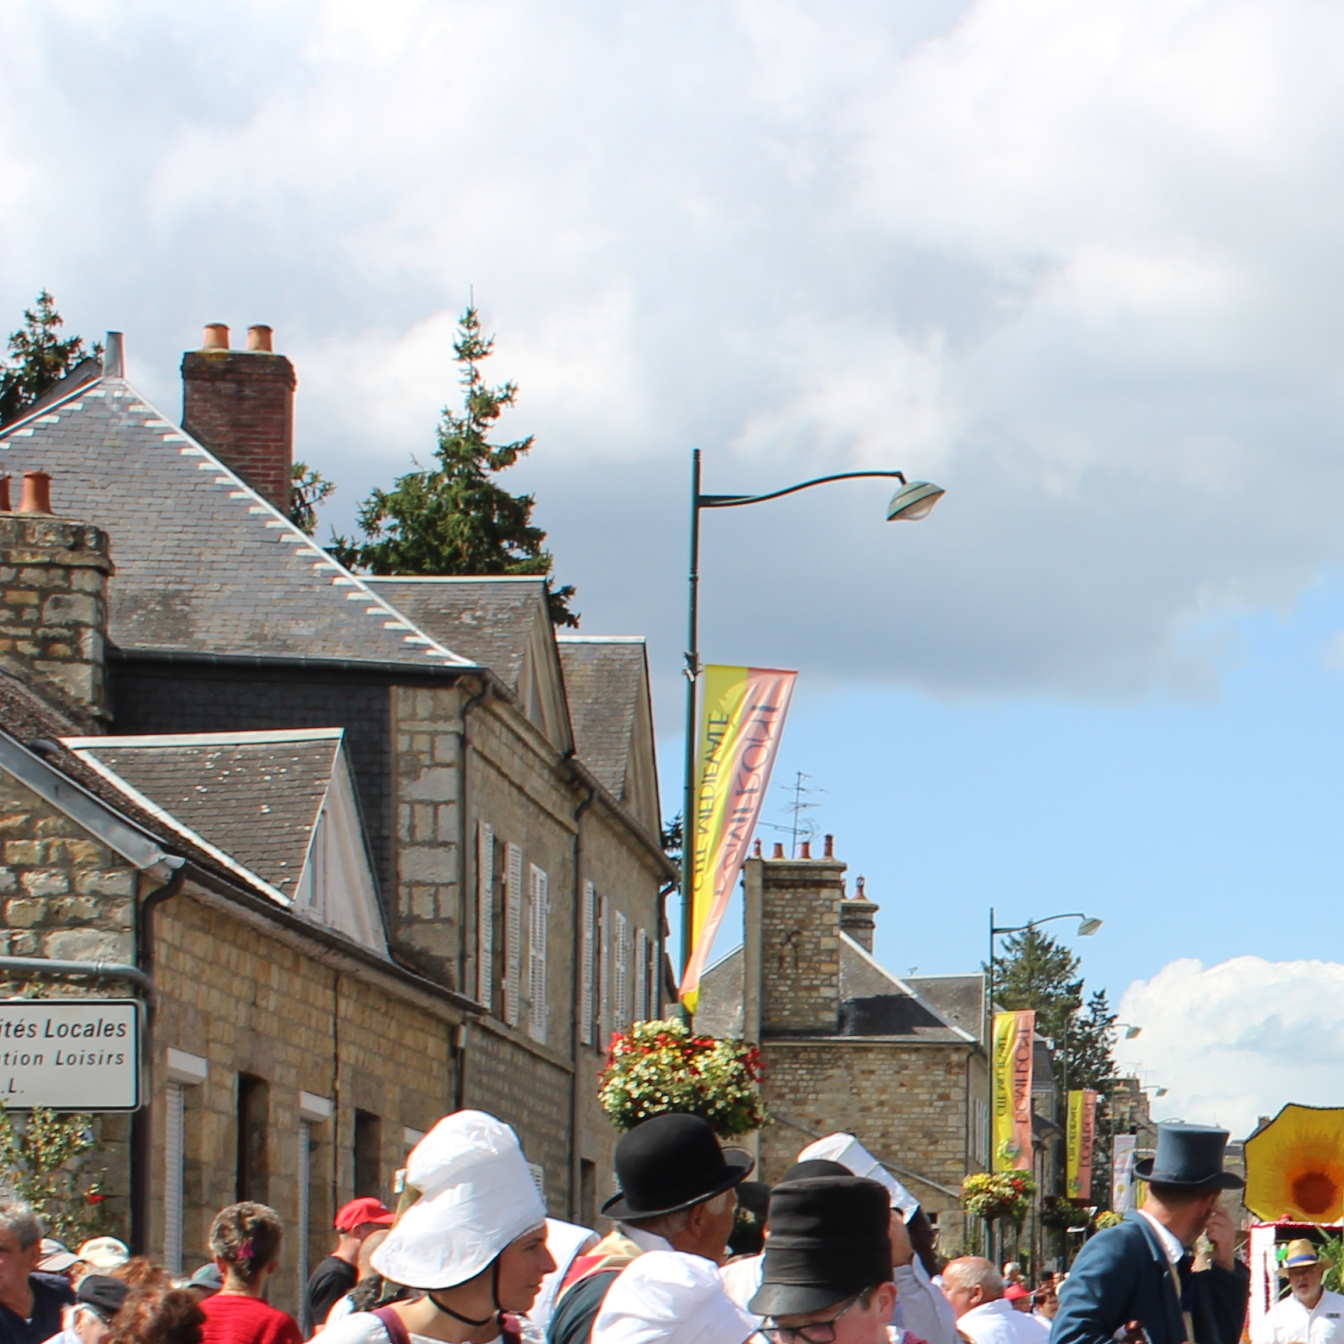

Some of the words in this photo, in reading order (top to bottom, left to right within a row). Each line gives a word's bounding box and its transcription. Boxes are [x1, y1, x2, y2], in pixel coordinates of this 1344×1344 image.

[45, 1018, 127, 1038] Locales
[0, 1051, 44, 1066] tion
[56, 1050, 125, 1066] Loisirs
